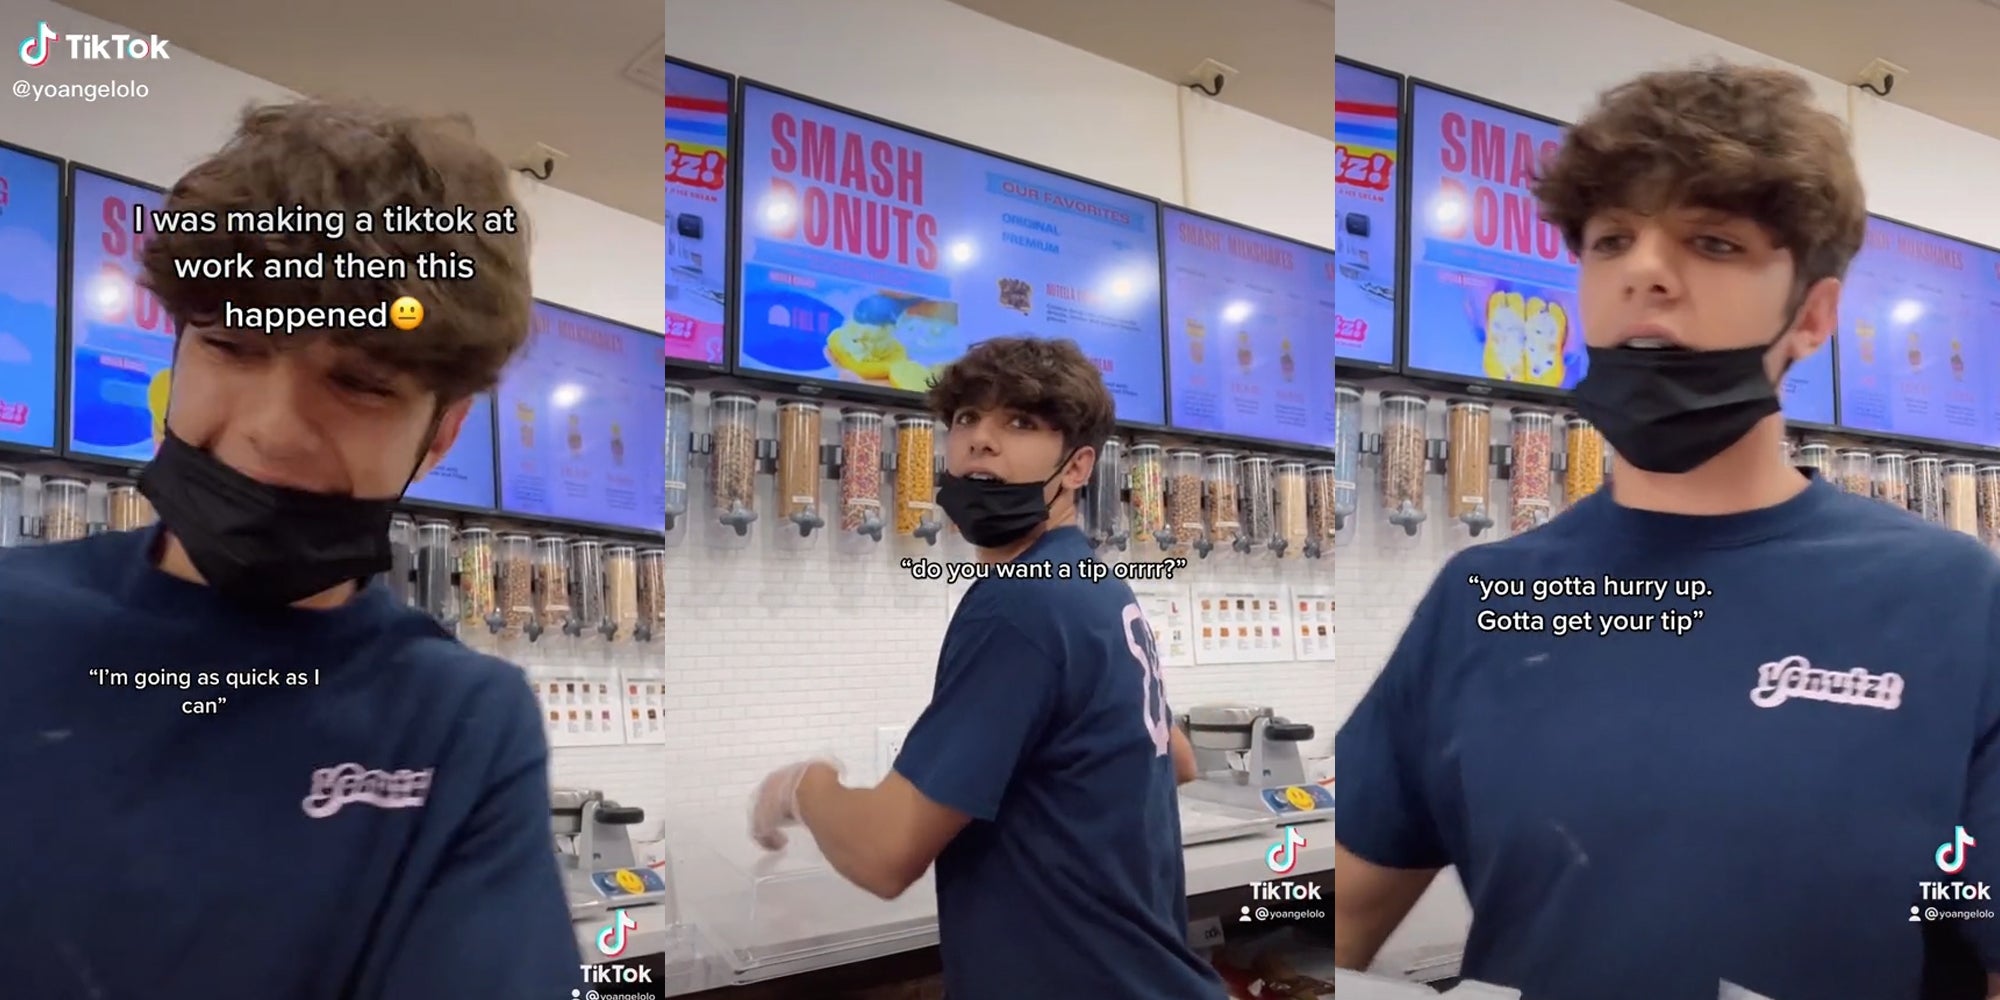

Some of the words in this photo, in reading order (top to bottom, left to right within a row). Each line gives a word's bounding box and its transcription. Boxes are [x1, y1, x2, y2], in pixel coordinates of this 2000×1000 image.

[771, 112, 922, 206] SMASH
[1002, 181, 1040, 200] OUR
[1044, 193, 1131, 225] FAVORITES
[1002, 213, 1060, 237] ORIGINAL
[1002, 232, 1060, 254] PREMIUM
